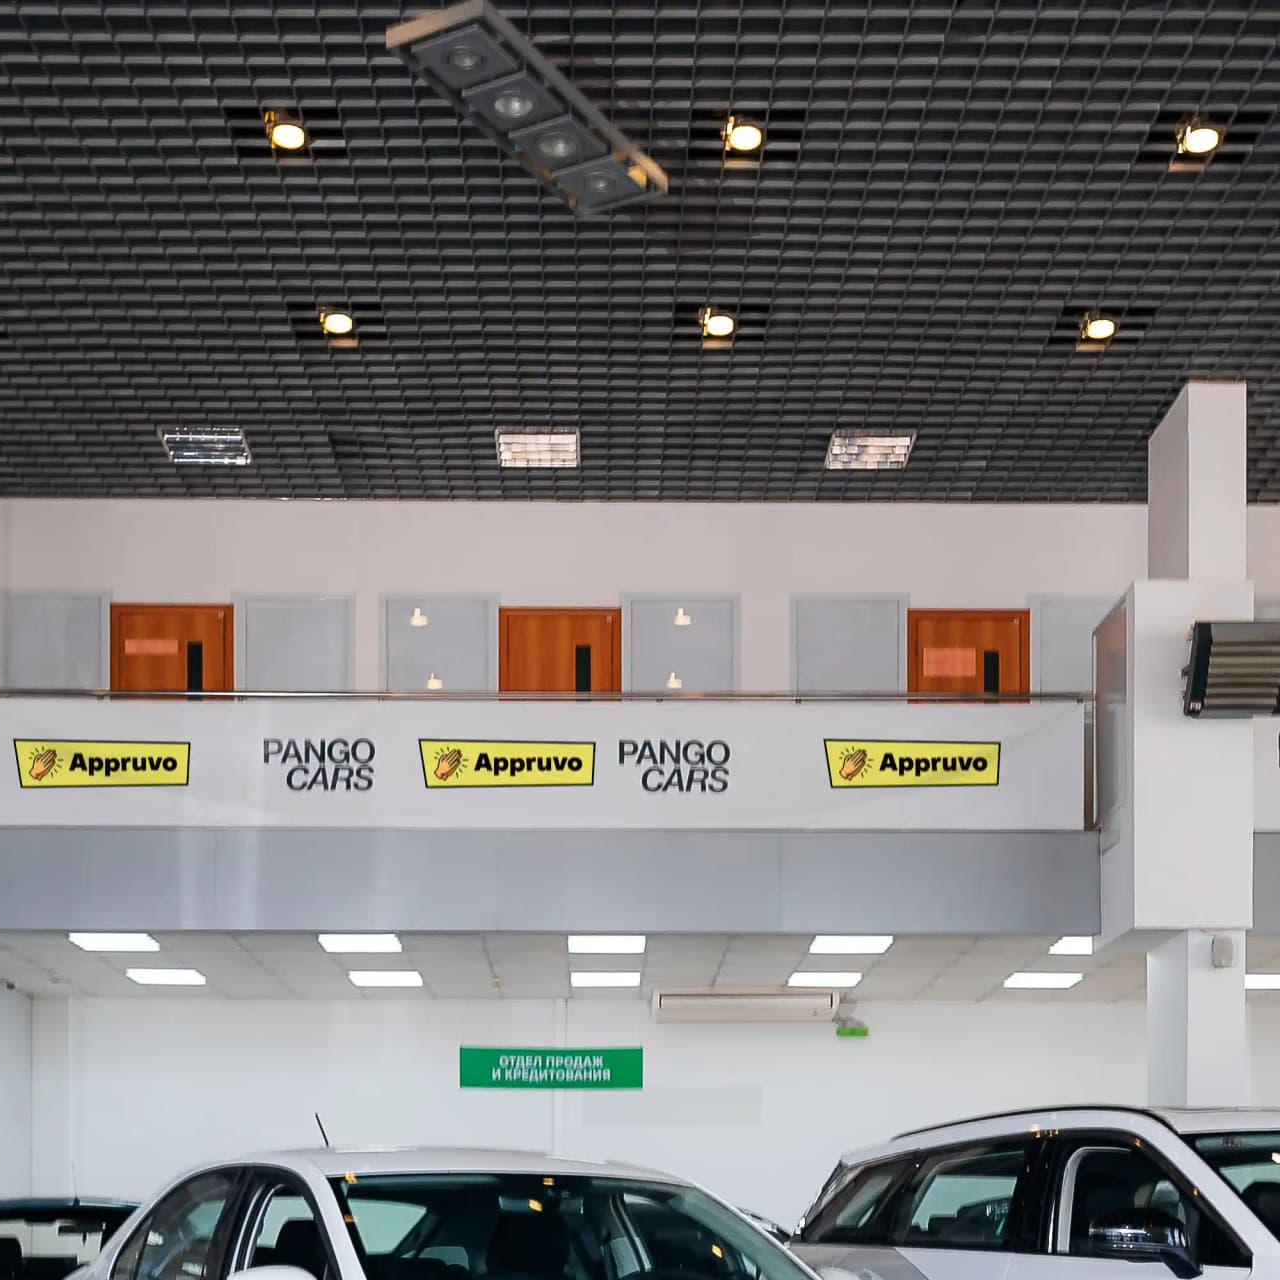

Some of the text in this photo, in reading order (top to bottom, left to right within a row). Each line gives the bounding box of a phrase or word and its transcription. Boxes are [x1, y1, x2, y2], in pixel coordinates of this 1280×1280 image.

[263, 737, 376, 766] PANGO
[618, 738, 731, 766] PANGO
[68, 752, 179, 776] Appruvo
[473, 752, 584, 776] Appruvo
[879, 752, 989, 776] Appruvo
[285, 765, 375, 792] CARS
[640, 766, 730, 793] CARS
[499, 1055, 603, 1069] ОТДЕЛ ПРОДАЖ
[492, 1067, 611, 1083] И КРЕДИТОВАНИЯ
